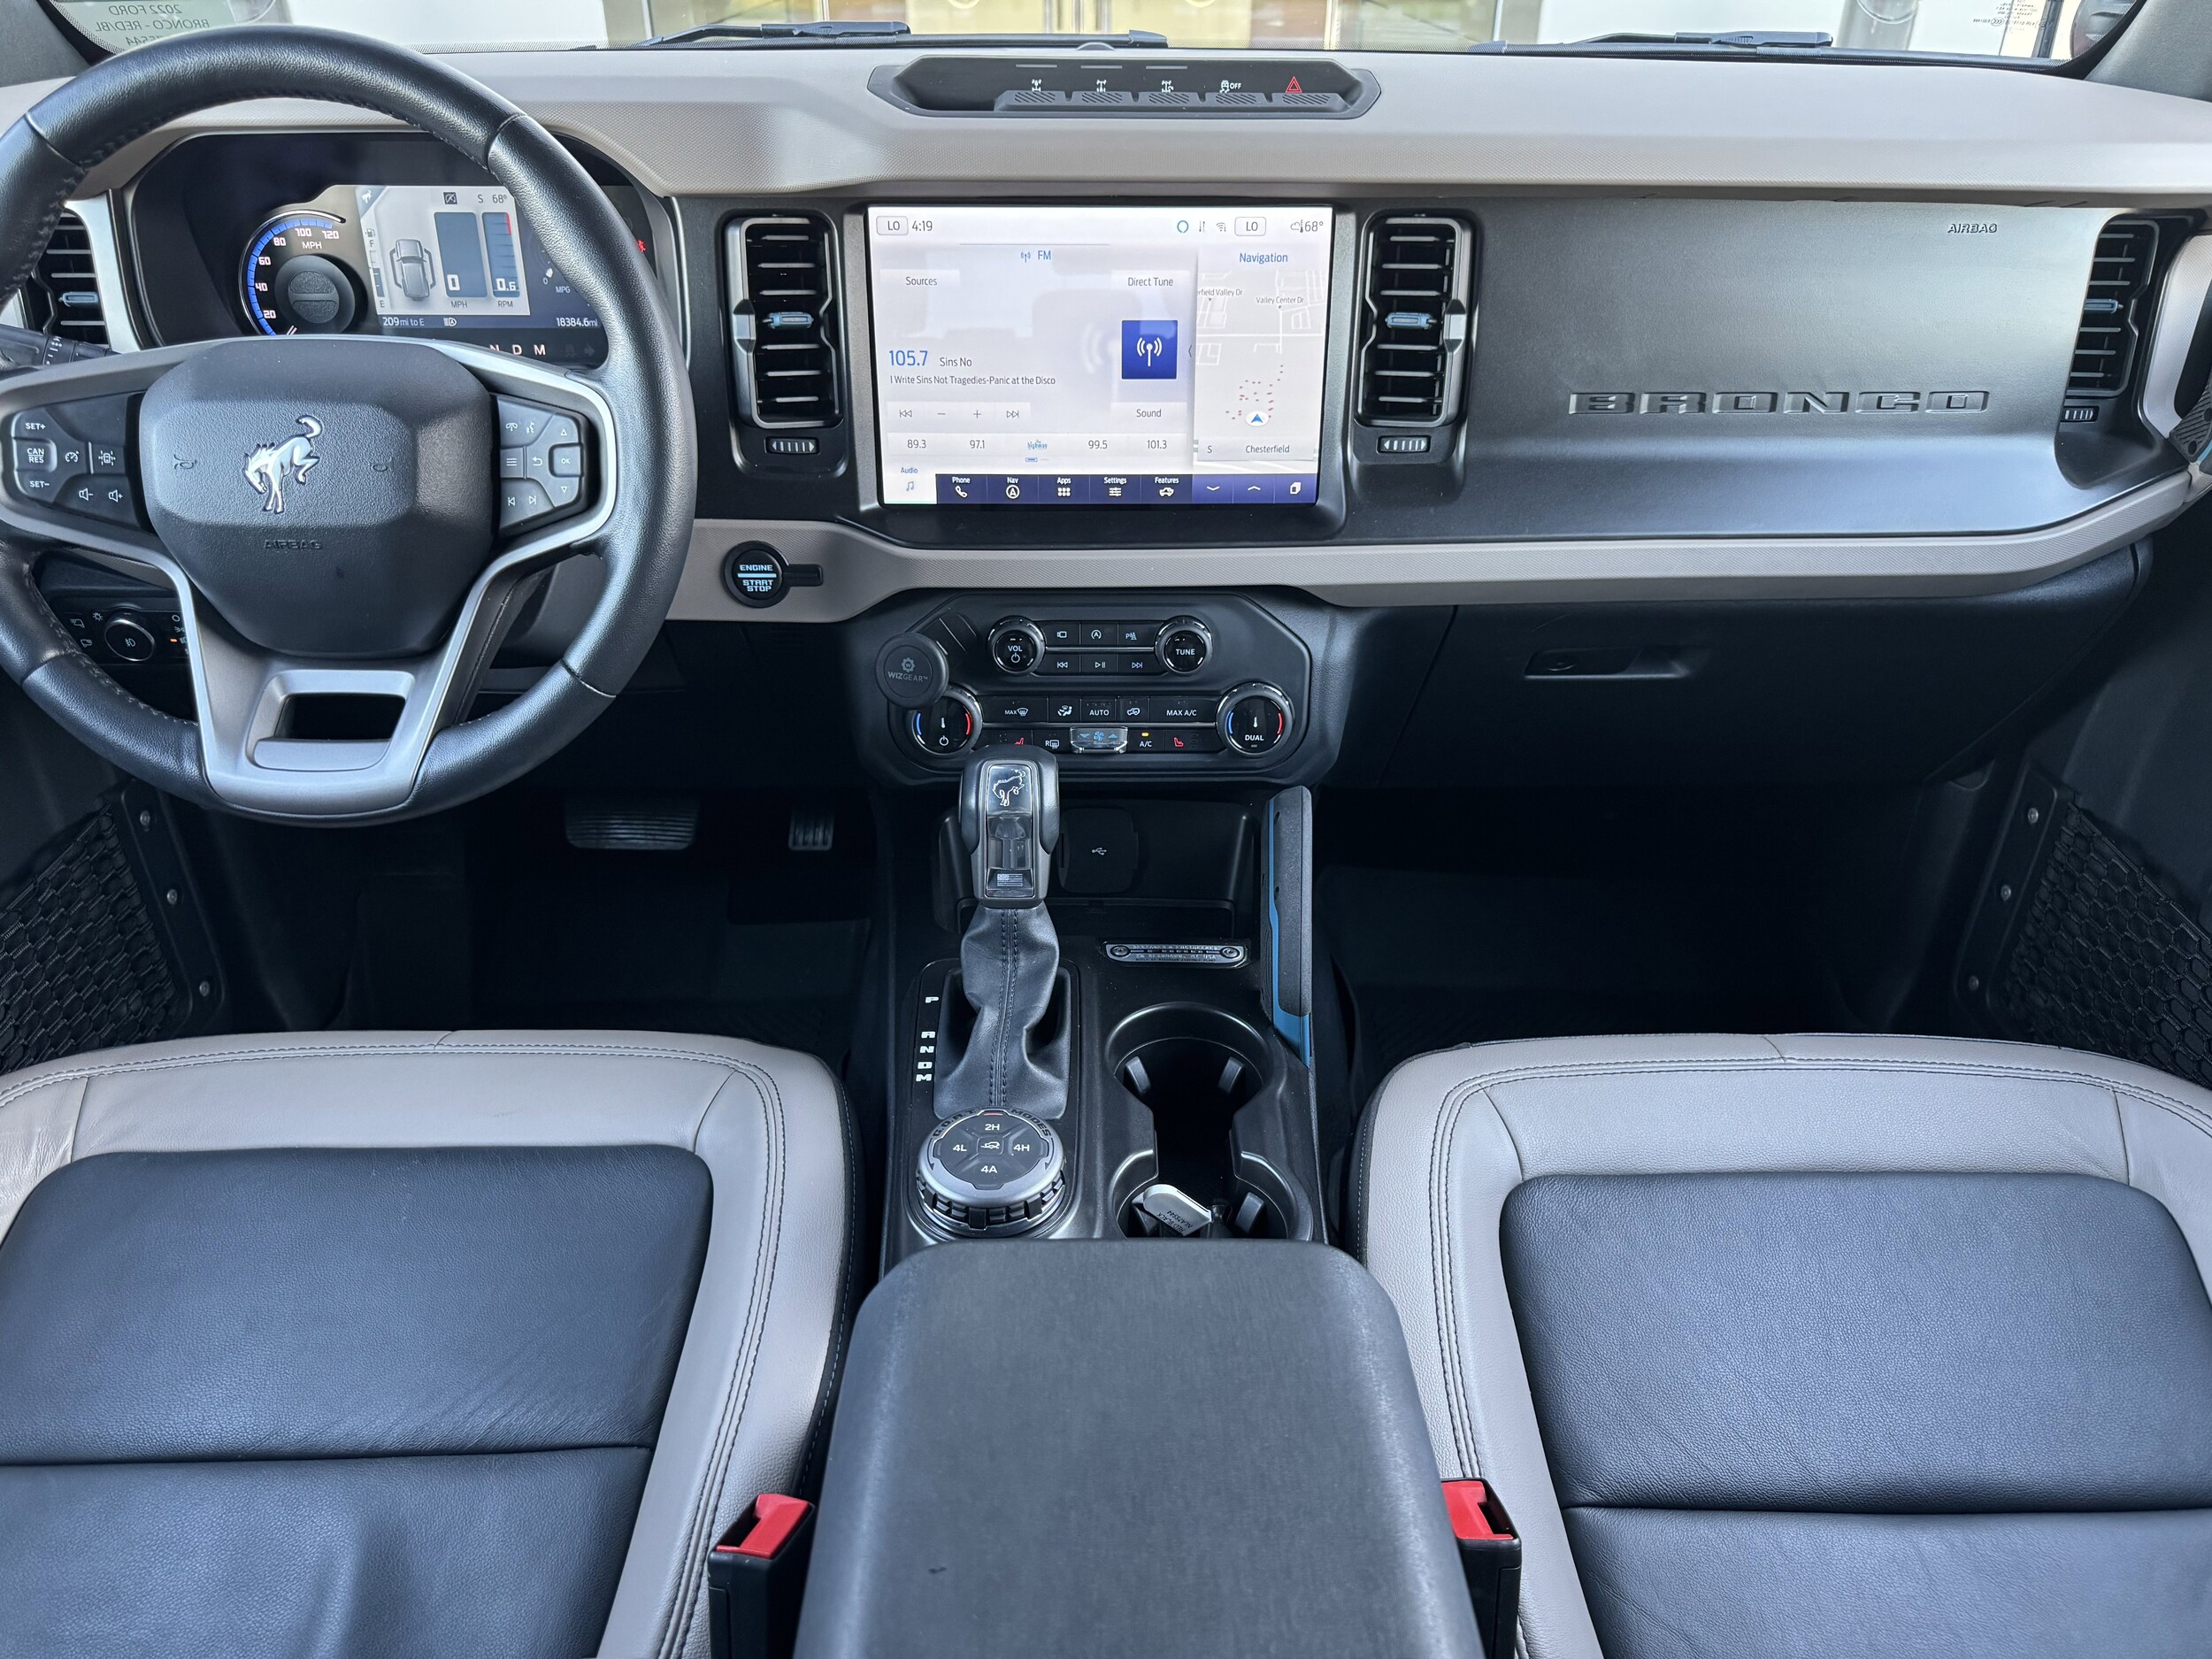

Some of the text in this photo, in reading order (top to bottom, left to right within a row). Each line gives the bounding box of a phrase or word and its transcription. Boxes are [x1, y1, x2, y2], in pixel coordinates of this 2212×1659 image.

[477, 195, 484, 204] S
[887, 220, 933, 232] LO 4:19
[1246, 221, 1258, 232] LO
[1947, 223, 1998, 233] AIRBAG
[295, 227, 312, 237] 100
[322, 230, 340, 239] 120
[273, 237, 287, 246] 80
[1037, 250, 1052, 260] FM
[1239, 253, 1288, 265] Navigation
[258, 257, 272, 265] 60
[447, 274, 460, 291] 0
[495, 278, 516, 291] 0.6
[905, 276, 938, 286] Sources
[1128, 278, 1173, 287] Direct Tune
[255, 282, 268, 292] 40
[264, 310, 276, 319] 20
[512, 344, 522, 355] D
[534, 344, 546, 356] M
[889, 349, 972, 367] 105.7 Sins No
[894, 375, 915, 384] Write
[933, 376, 948, 385] Not
[949, 376, 1010, 386] Tragedies-Panic
[1021, 376, 1034, 385] the
[1035, 376, 1056, 385] Disco
[1568, 391, 1990, 414] BRONCO
[1136, 408, 1162, 418] Sound
[907, 440, 926, 449] 89.3
[970, 440, 985, 449] 97.1
[1088, 440, 1108, 449] 99.5
[1147, 440, 1167, 449] 101.3
[1245, 445, 1290, 454] Chesterfield
[1103, 477, 1127, 486] Settings
[265, 540, 321, 549] AIRBAG
[916, 1073, 933, 1082] M
[1010, 1109, 1051, 1137] MODES
